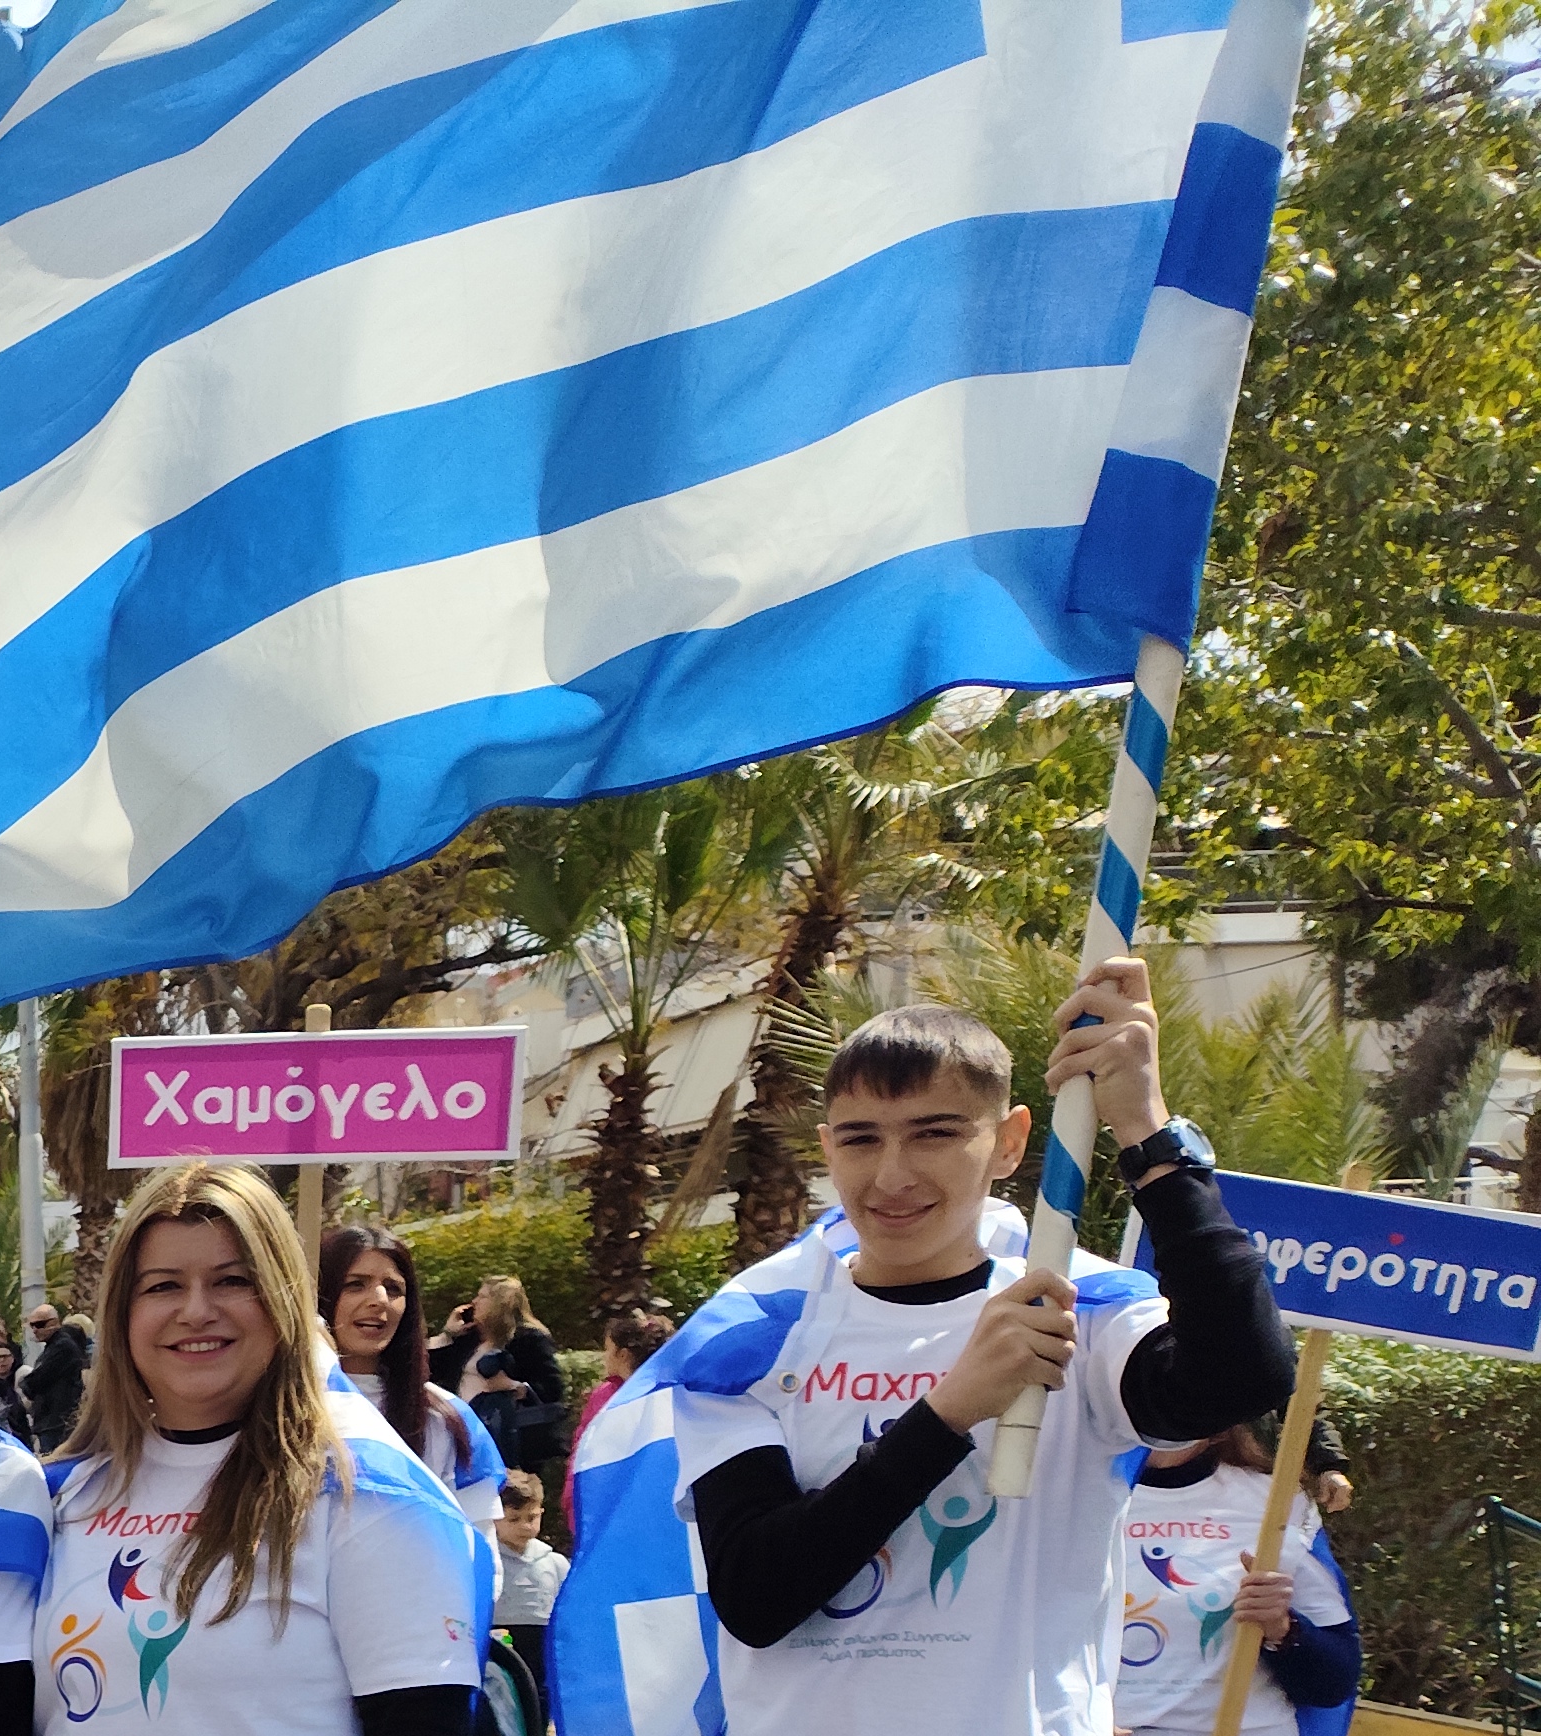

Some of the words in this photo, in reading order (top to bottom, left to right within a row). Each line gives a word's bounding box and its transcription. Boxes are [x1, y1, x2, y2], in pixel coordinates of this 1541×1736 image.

[144, 1063, 486, 1140] Χαμόγελο
[1253, 1231, 1538, 1315] φερότητα
[804, 1362, 949, 1404] Μαχη
[85, 1506, 203, 1538] Μαχητ
[1125, 1516, 1232, 1540] αχητές
